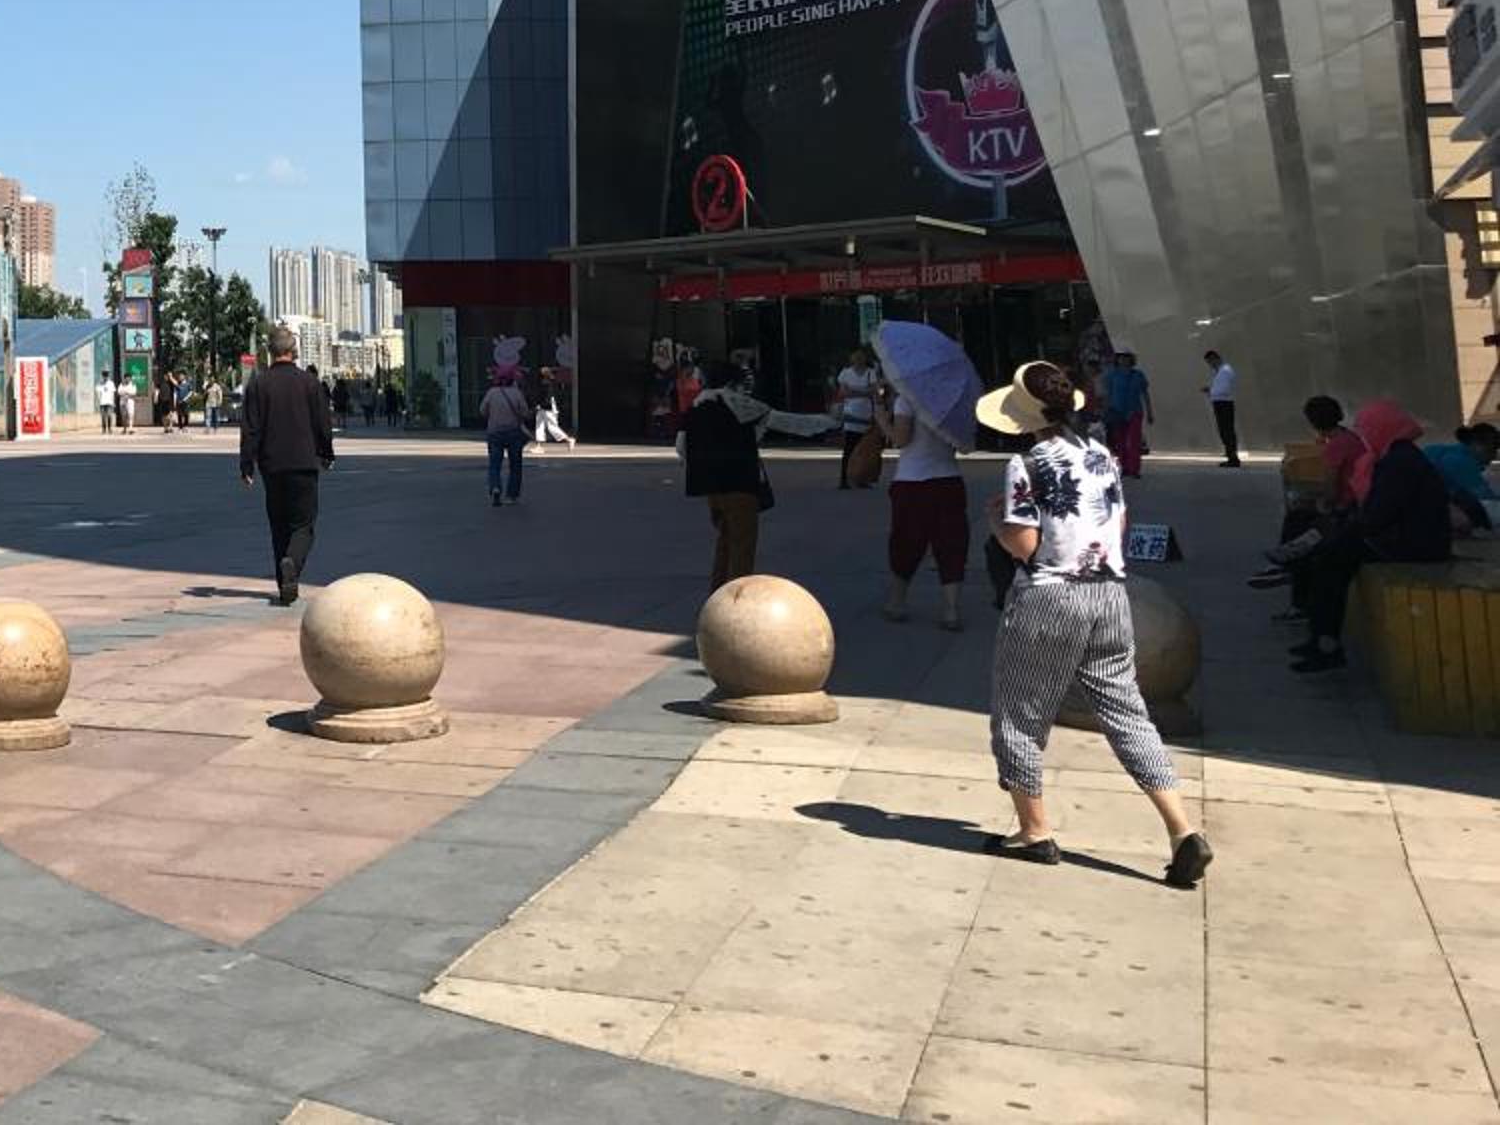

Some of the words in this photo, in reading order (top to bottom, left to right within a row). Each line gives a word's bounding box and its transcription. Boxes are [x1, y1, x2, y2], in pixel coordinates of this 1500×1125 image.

[725, 11, 789, 38] PEOPLE
[791, 1, 836, 24] SING
[968, 126, 1027, 163] KTV
